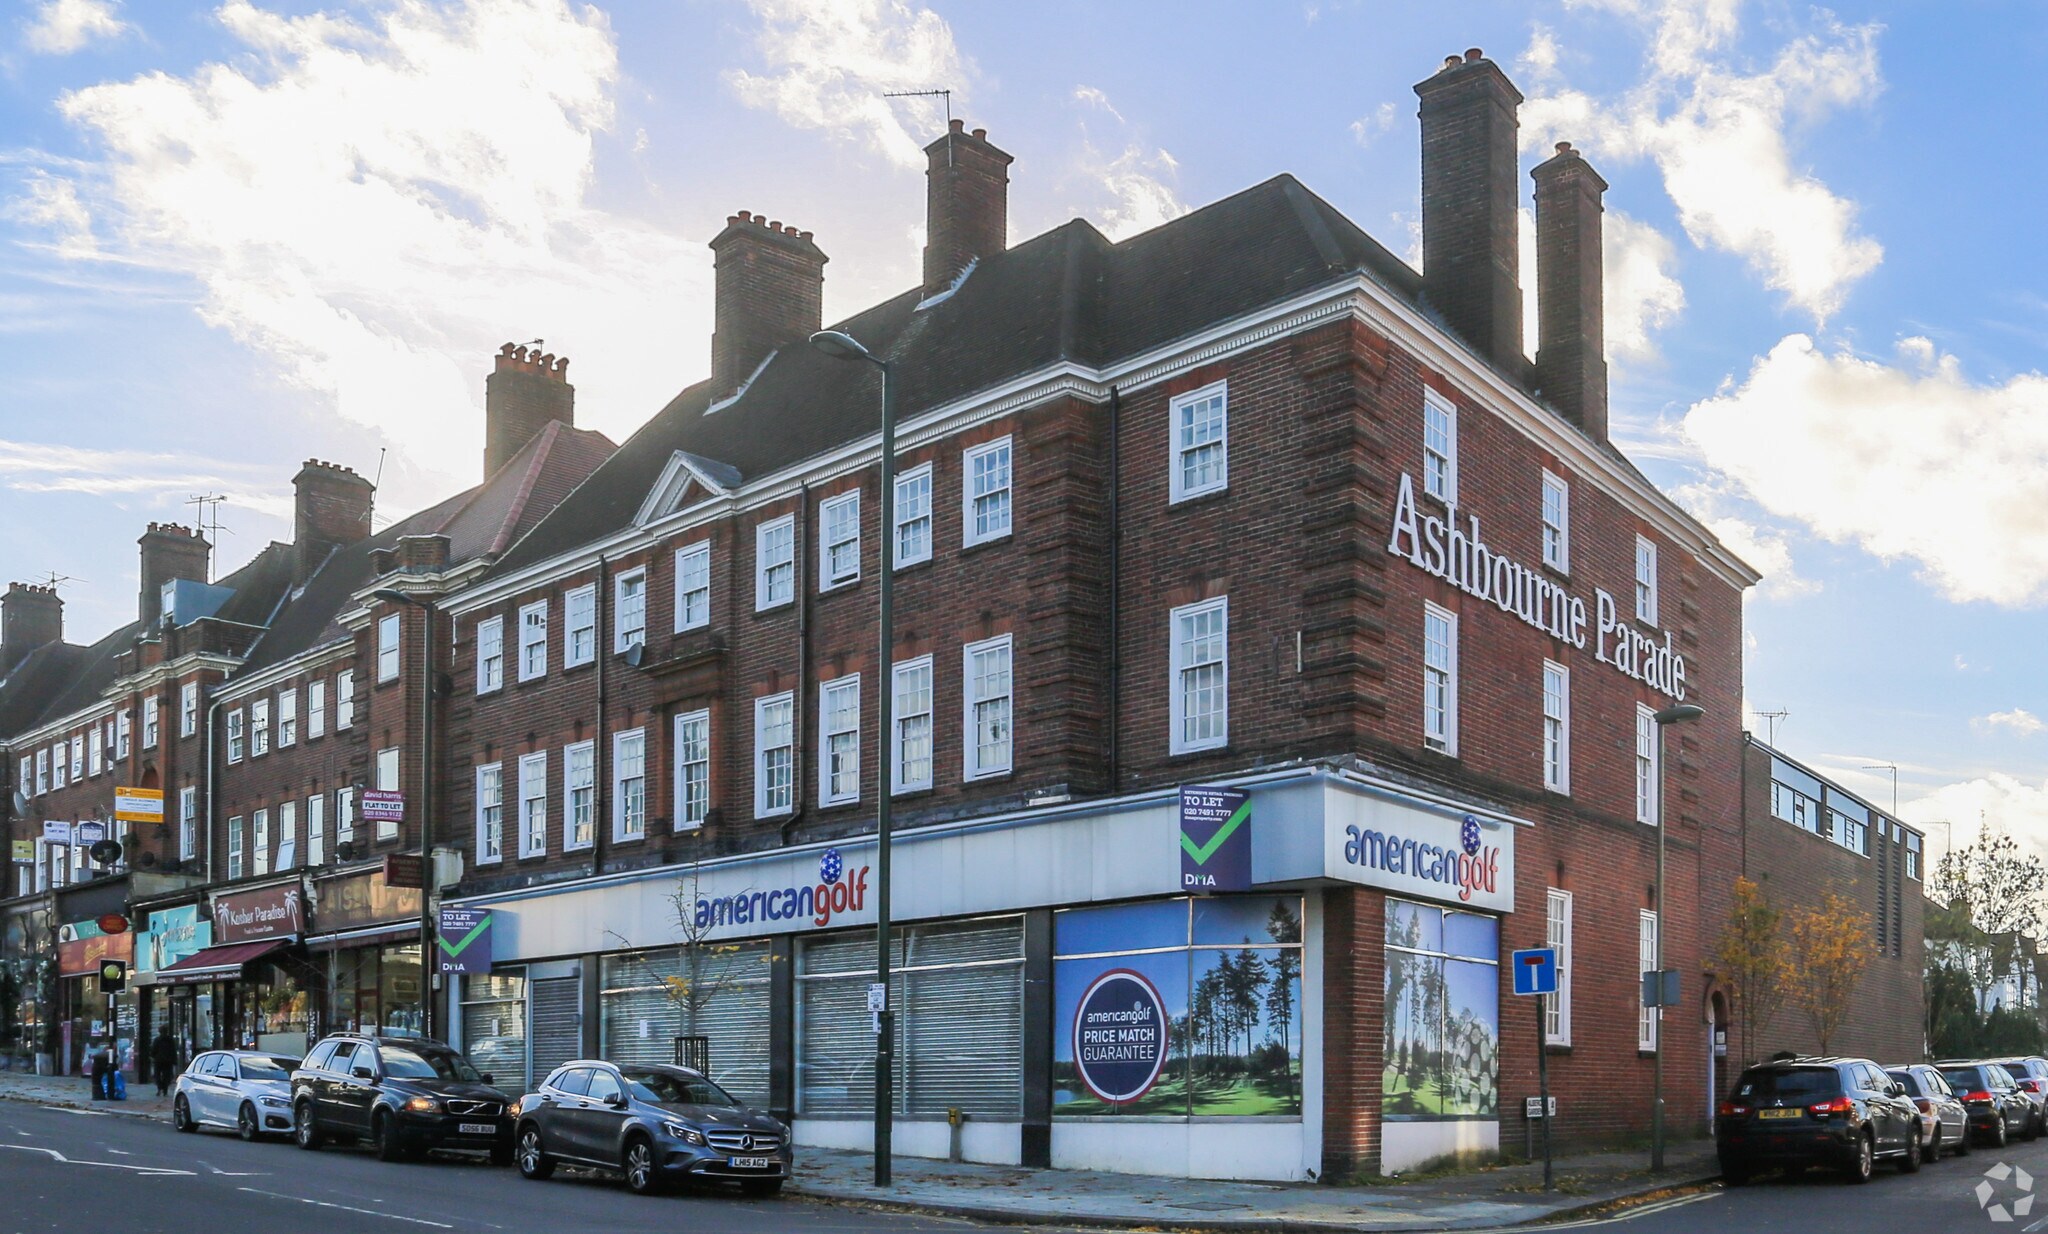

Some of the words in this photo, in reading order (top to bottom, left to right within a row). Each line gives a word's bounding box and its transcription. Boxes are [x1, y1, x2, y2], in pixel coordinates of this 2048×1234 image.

[1388, 472, 1586, 649] Ashbourne
[1594, 587, 1686, 701] Parade
[1184, 796, 1200, 806] TO
[1202, 797, 1223, 807] LET
[1185, 873, 1216, 886] DMA
[230, 908, 254, 926] Kosher
[255, 903, 286, 922] Paradise
[443, 913, 454, 921] TO
[1087, 1006, 1152, 1025] americangolf
[1084, 1029, 1116, 1044] PRICE
[1118, 1028, 1155, 1042] MATCH
[1083, 1045, 1155, 1061] GUARANTEE
[735, 1158, 751, 1167] LH15
[752, 1158, 766, 1166] AGZ
